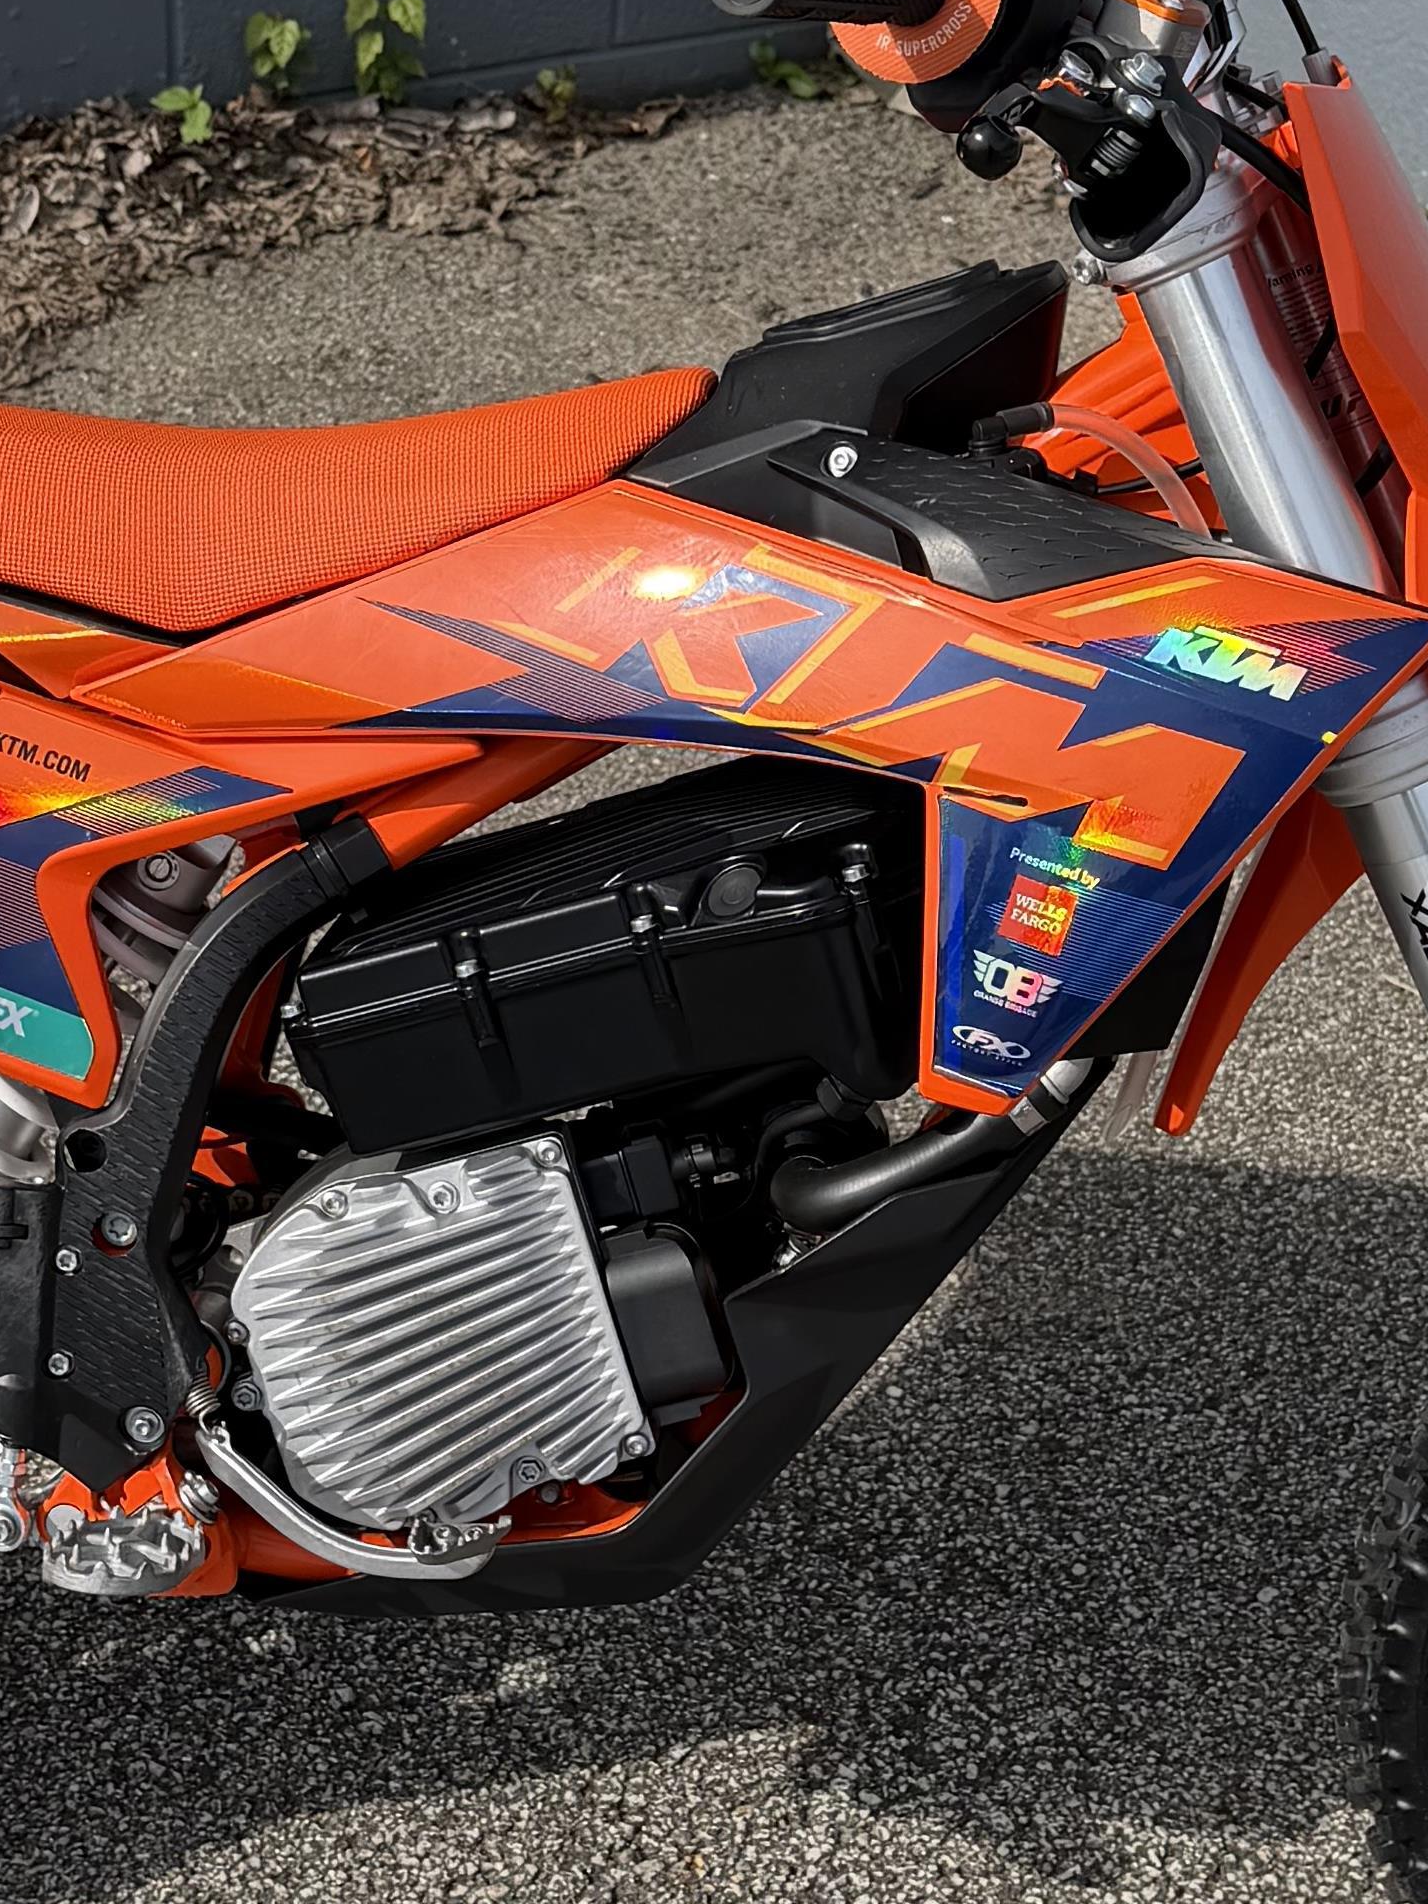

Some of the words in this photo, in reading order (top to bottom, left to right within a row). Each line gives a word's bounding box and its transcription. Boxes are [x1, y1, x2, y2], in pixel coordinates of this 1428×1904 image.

[895, 1, 973, 57] SUPERCROSS
[1143, 625, 1308, 702] KTM
[1009, 847, 1082, 882] Presented
[1080, 867, 1101, 891] by
[1010, 908, 1062, 935] FARGO
[1015, 893, 1069, 922] WELLS
